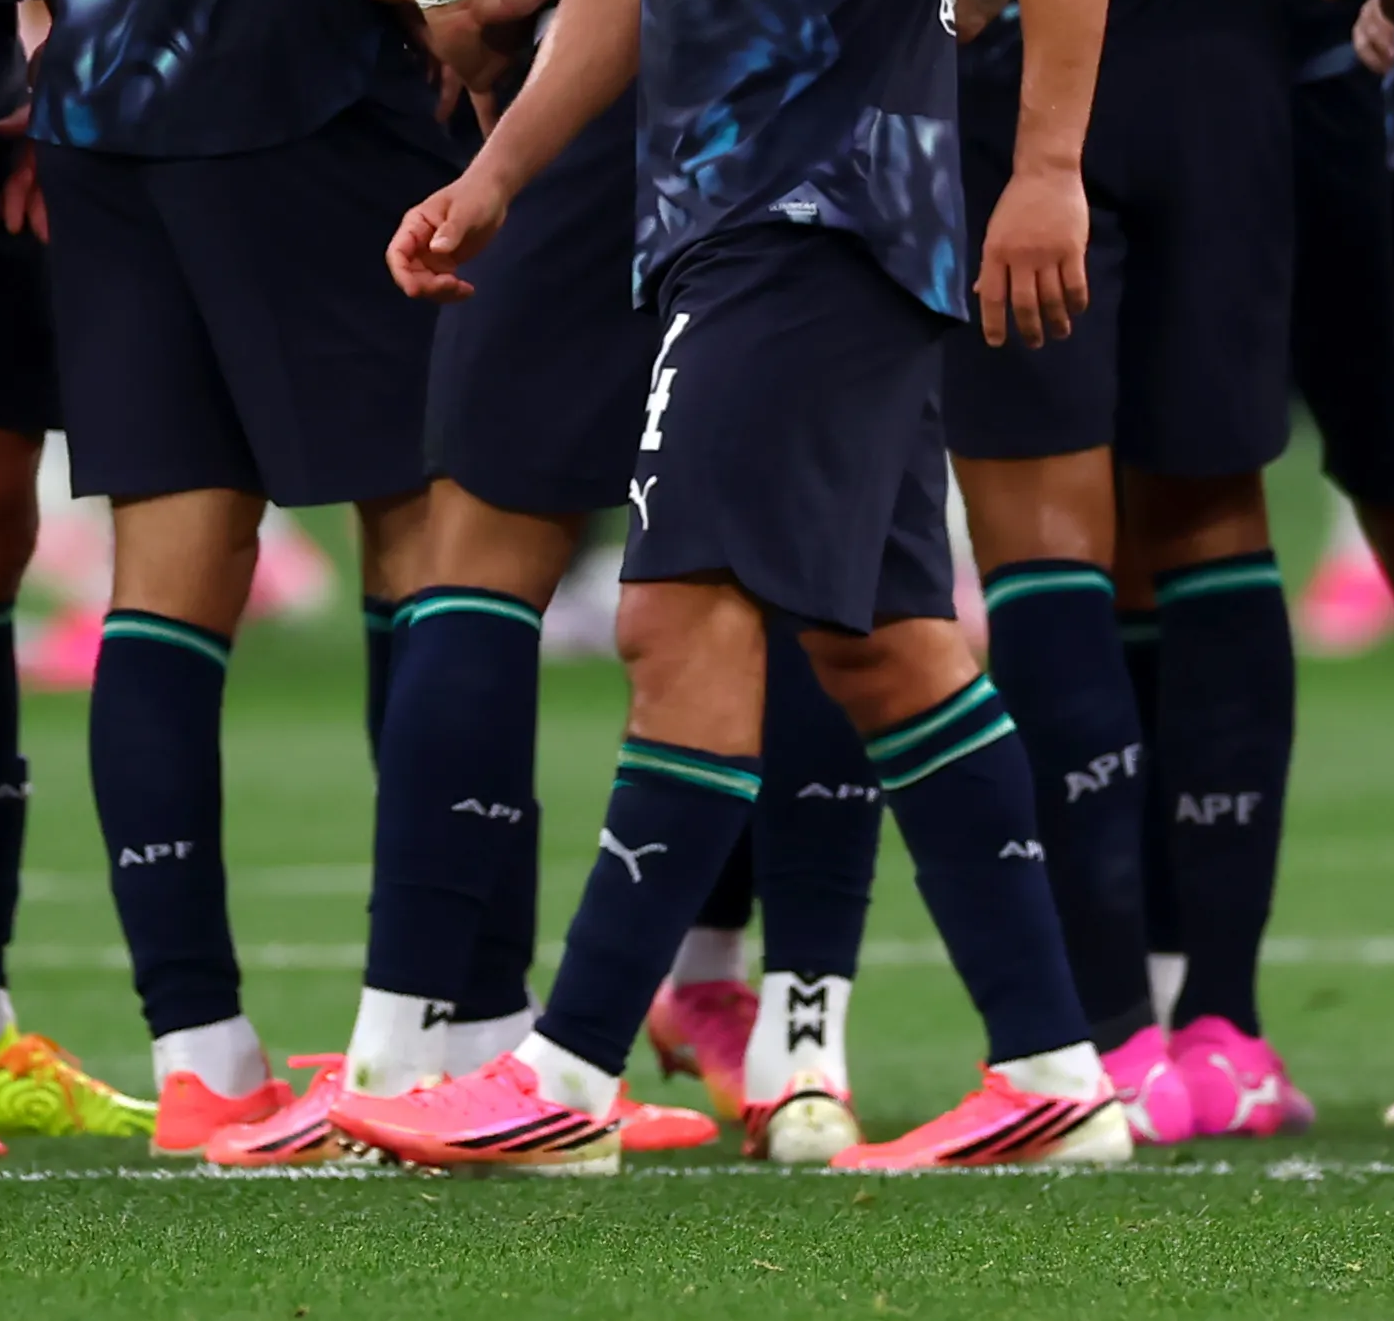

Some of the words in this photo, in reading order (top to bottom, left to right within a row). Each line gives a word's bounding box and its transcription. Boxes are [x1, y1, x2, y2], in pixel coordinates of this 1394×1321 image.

[1064, 742, 1142, 804] APF
[1175, 791, 1263, 825] APF
[118, 839, 195, 868] APF
